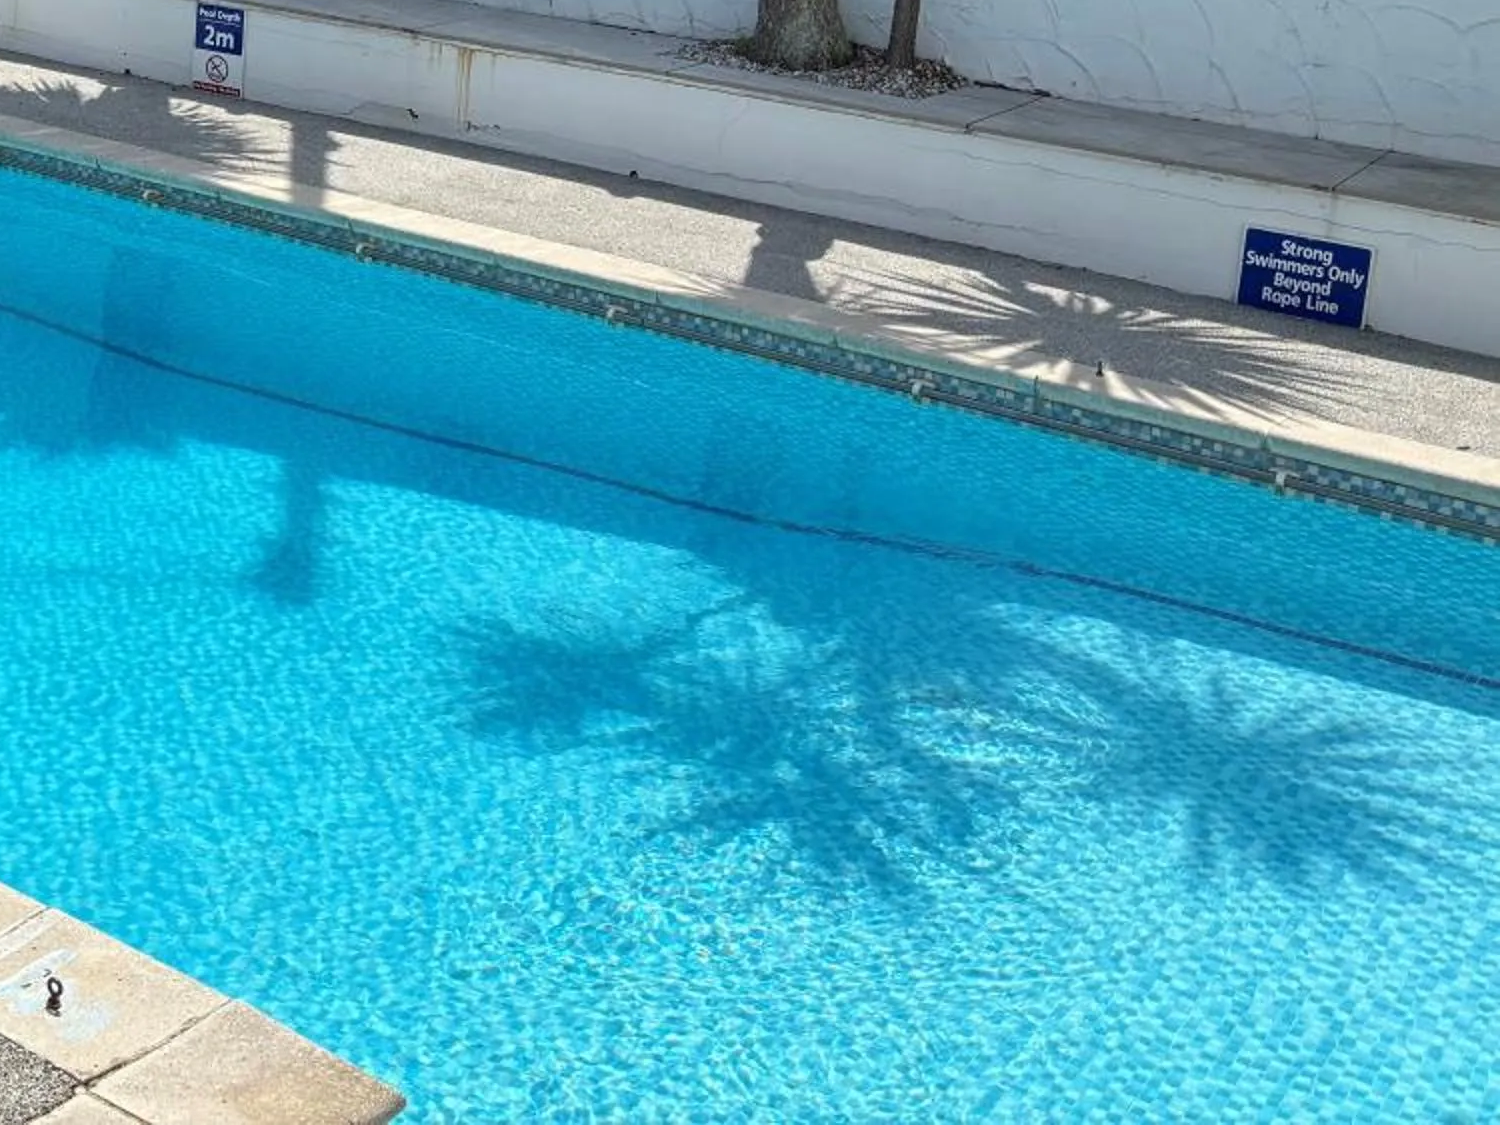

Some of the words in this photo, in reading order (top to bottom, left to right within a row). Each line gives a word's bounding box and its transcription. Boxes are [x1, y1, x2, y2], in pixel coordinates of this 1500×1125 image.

[199, 7, 216, 18] Pool
[217, 11, 241, 23] Depth
[203, 24, 235, 50] 2m
[1281, 239, 1333, 266] Strong
[1245, 250, 1324, 278] Swimmers
[1328, 266, 1365, 290] Only
[1273, 272, 1331, 296] Beyond
[1261, 286, 1301, 308] Rope
[1305, 295, 1339, 315] Line
